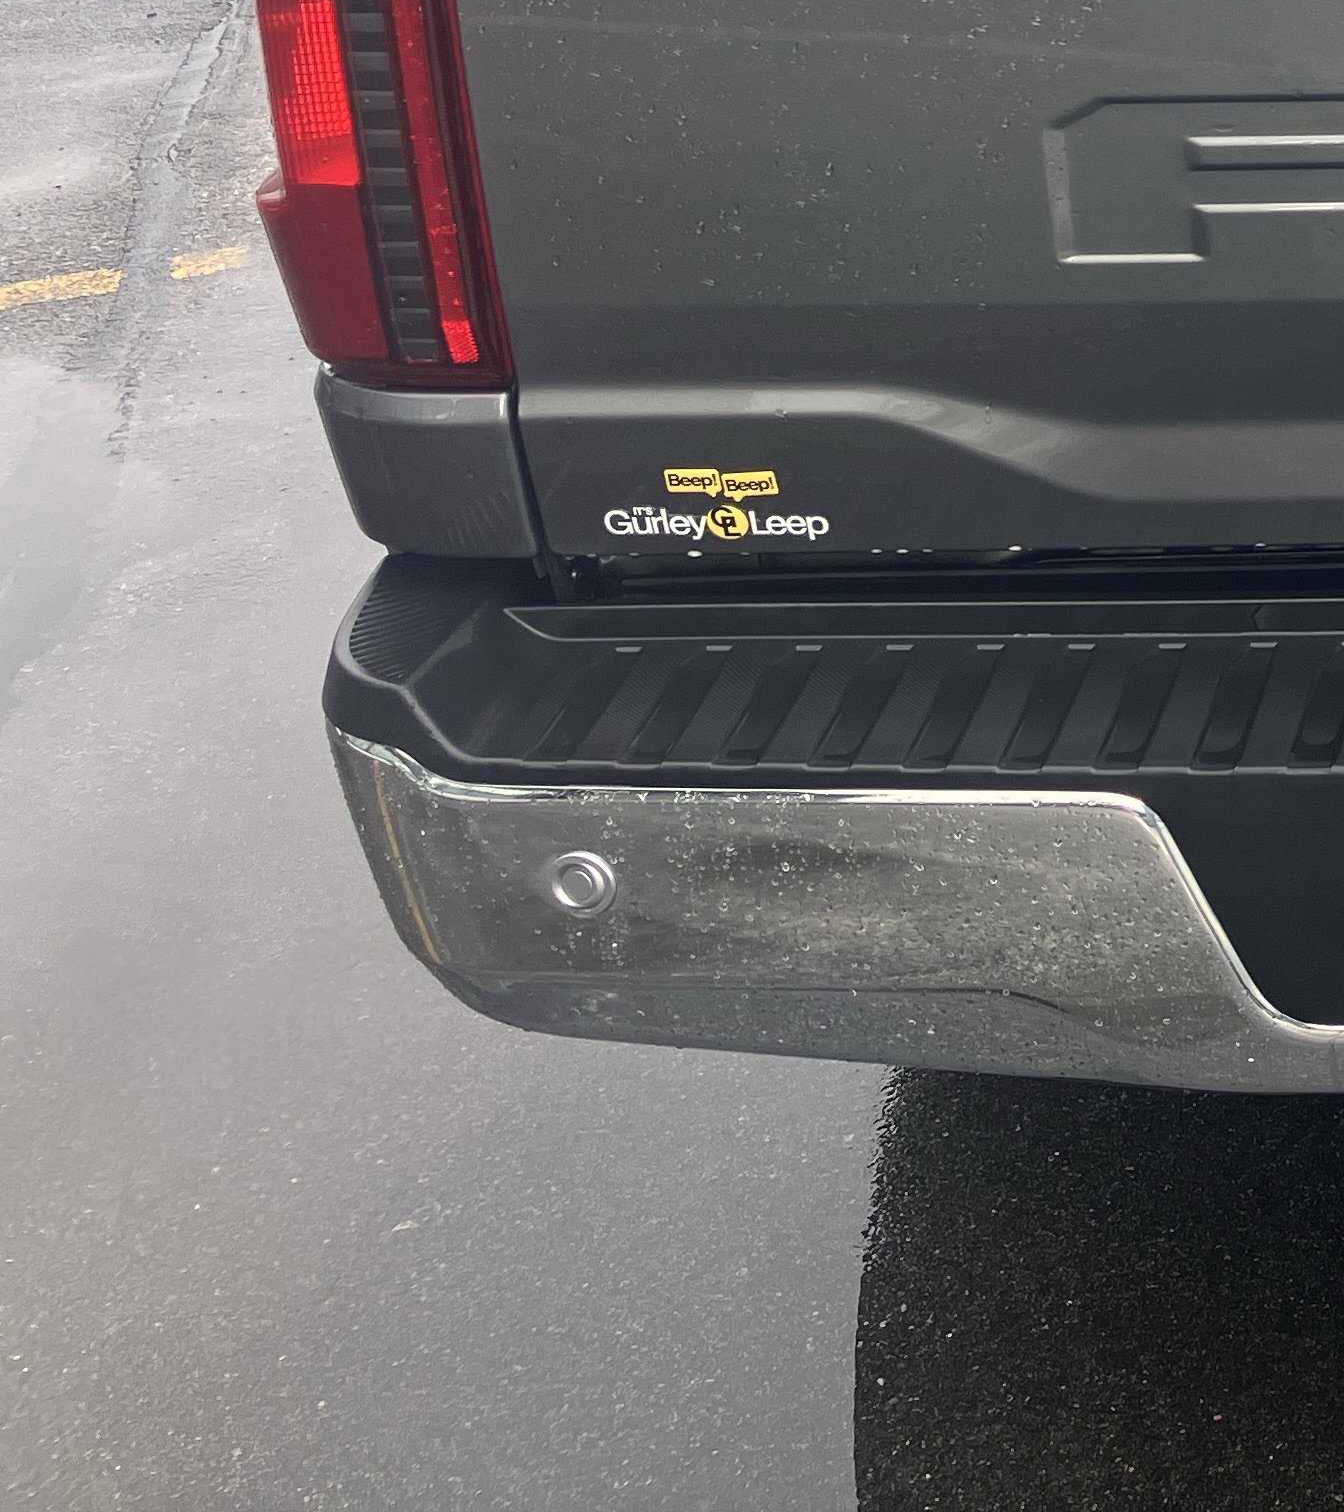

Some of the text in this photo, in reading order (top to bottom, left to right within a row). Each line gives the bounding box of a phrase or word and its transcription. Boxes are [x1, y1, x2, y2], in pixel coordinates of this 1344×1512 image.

[667, 473, 775, 492] Beep! Beep!
[604, 508, 708, 540] Gurley
[748, 510, 830, 541] Leep
